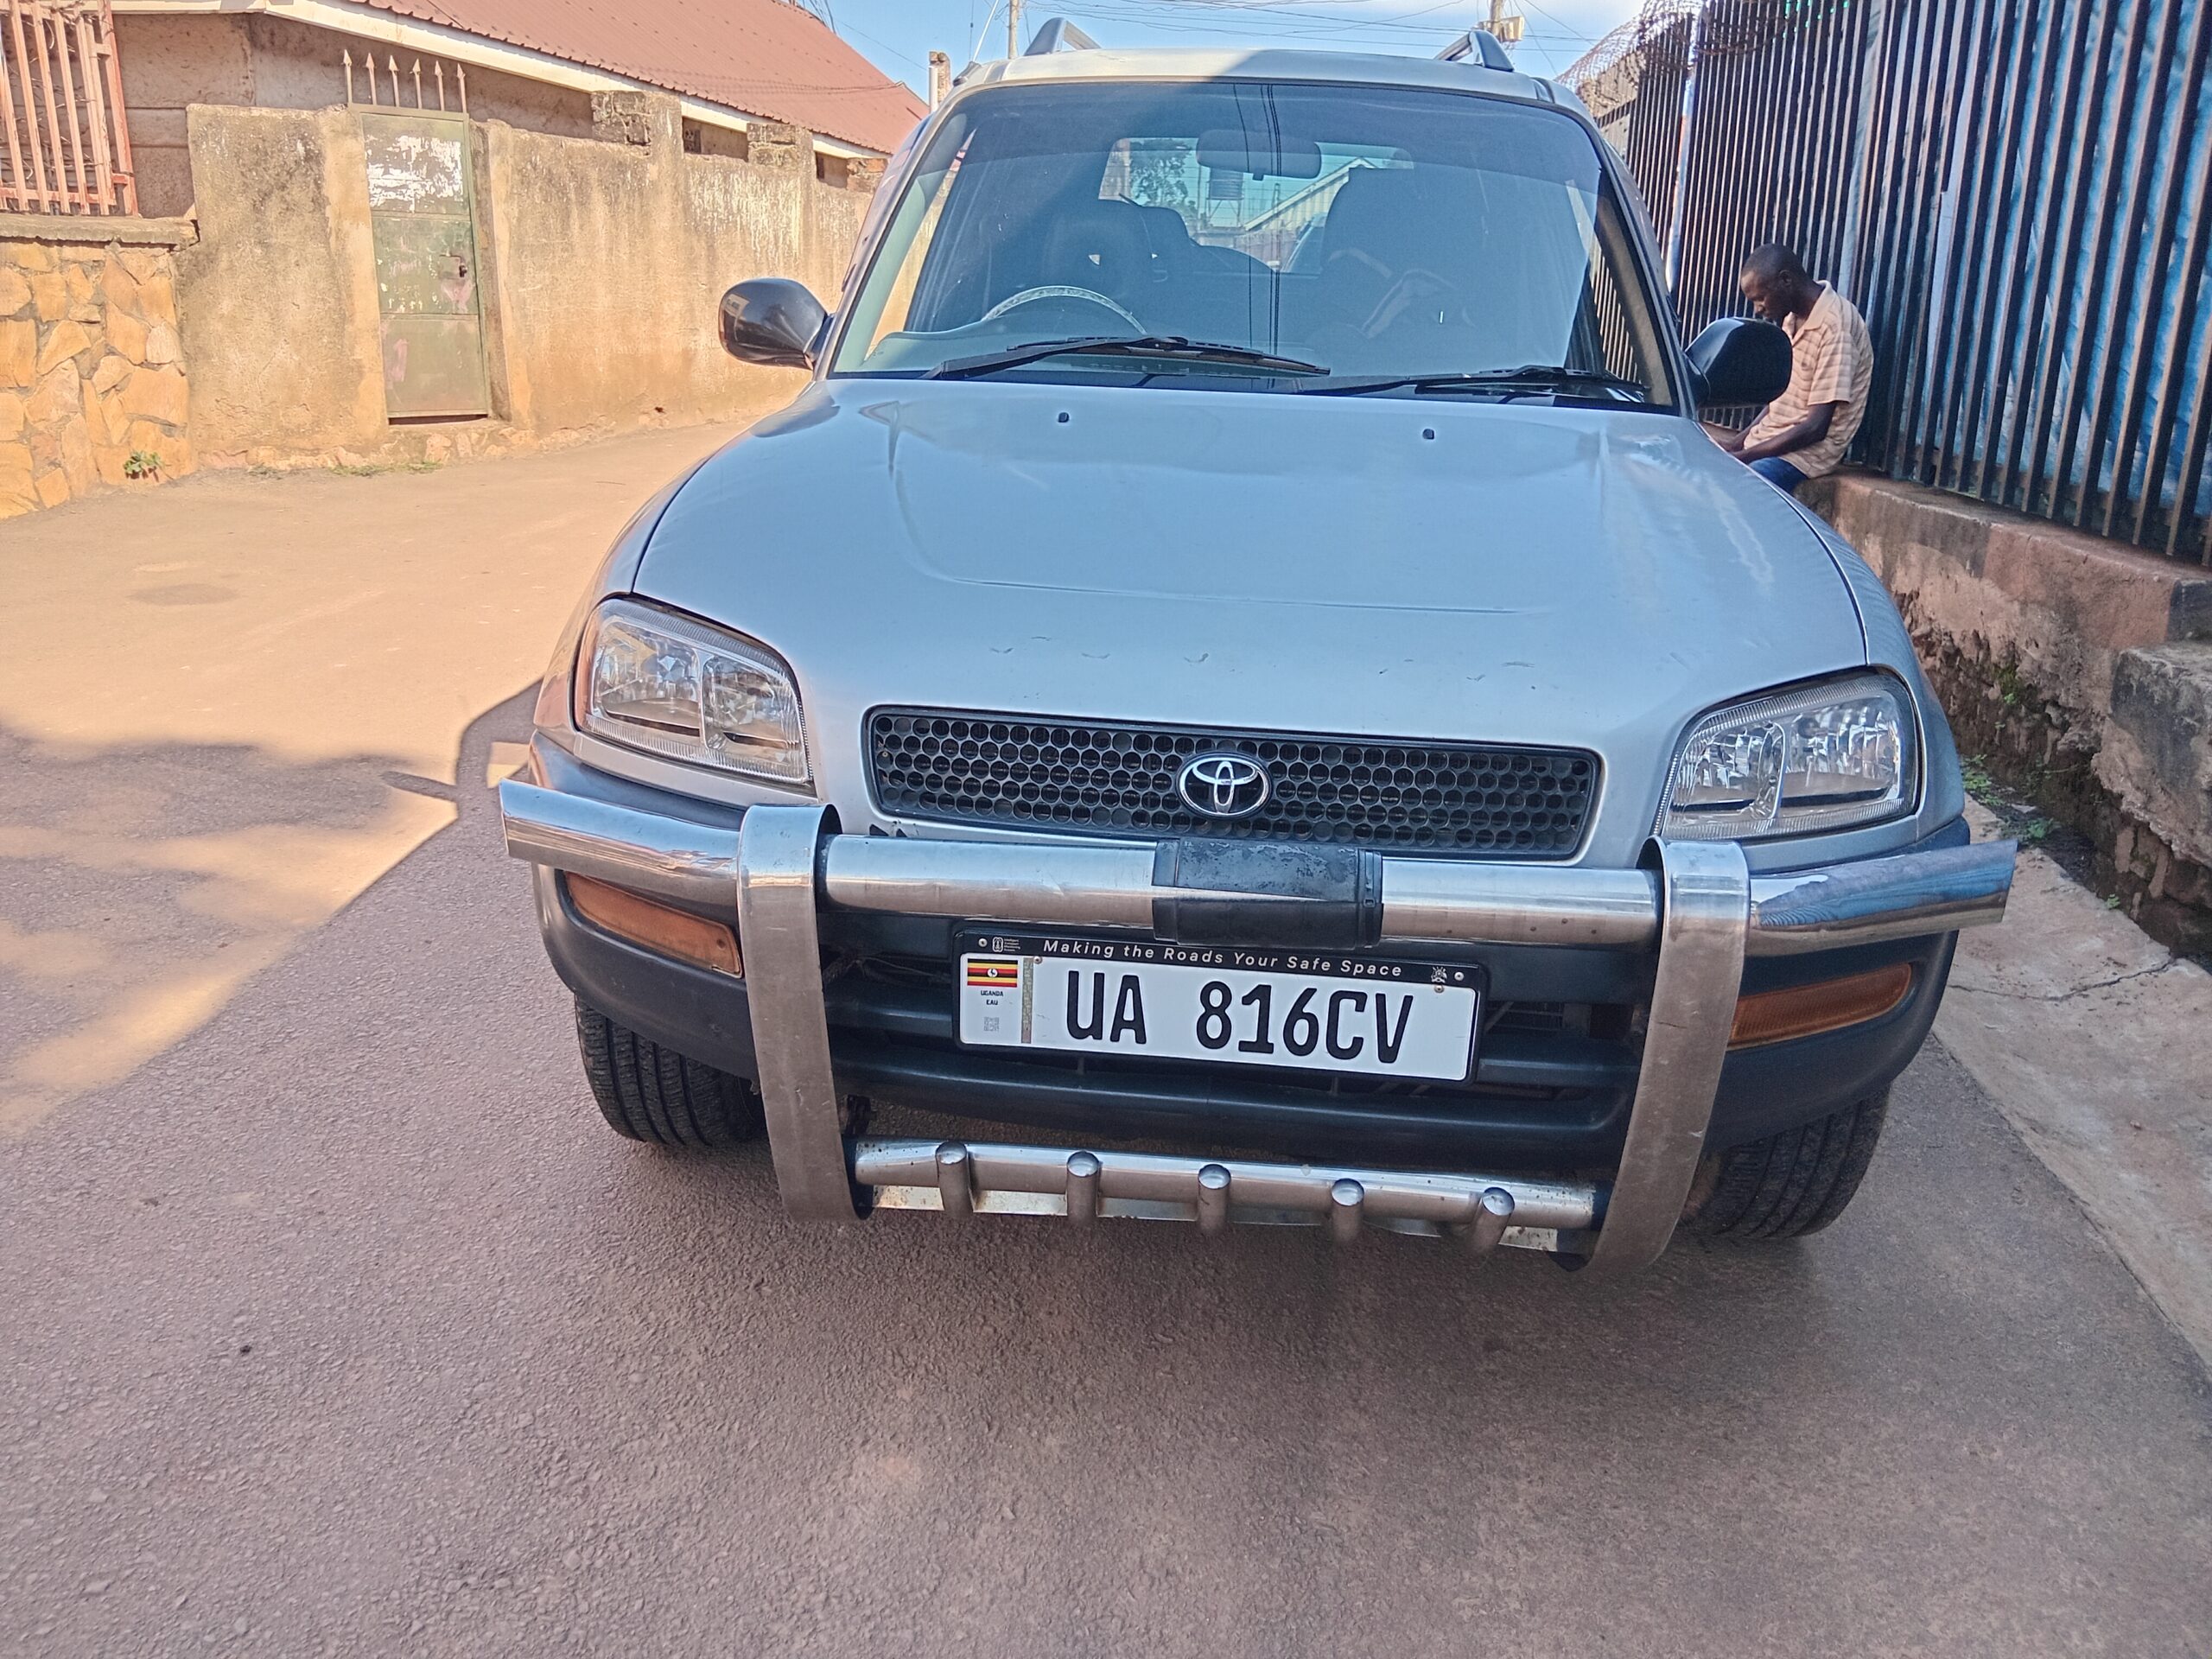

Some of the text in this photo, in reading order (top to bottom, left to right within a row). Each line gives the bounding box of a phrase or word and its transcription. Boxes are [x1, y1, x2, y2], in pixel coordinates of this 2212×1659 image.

[1043, 939, 1402, 976] Making the Roads Your Safe Space
[1066, 969, 1414, 1064] UA 816CV
